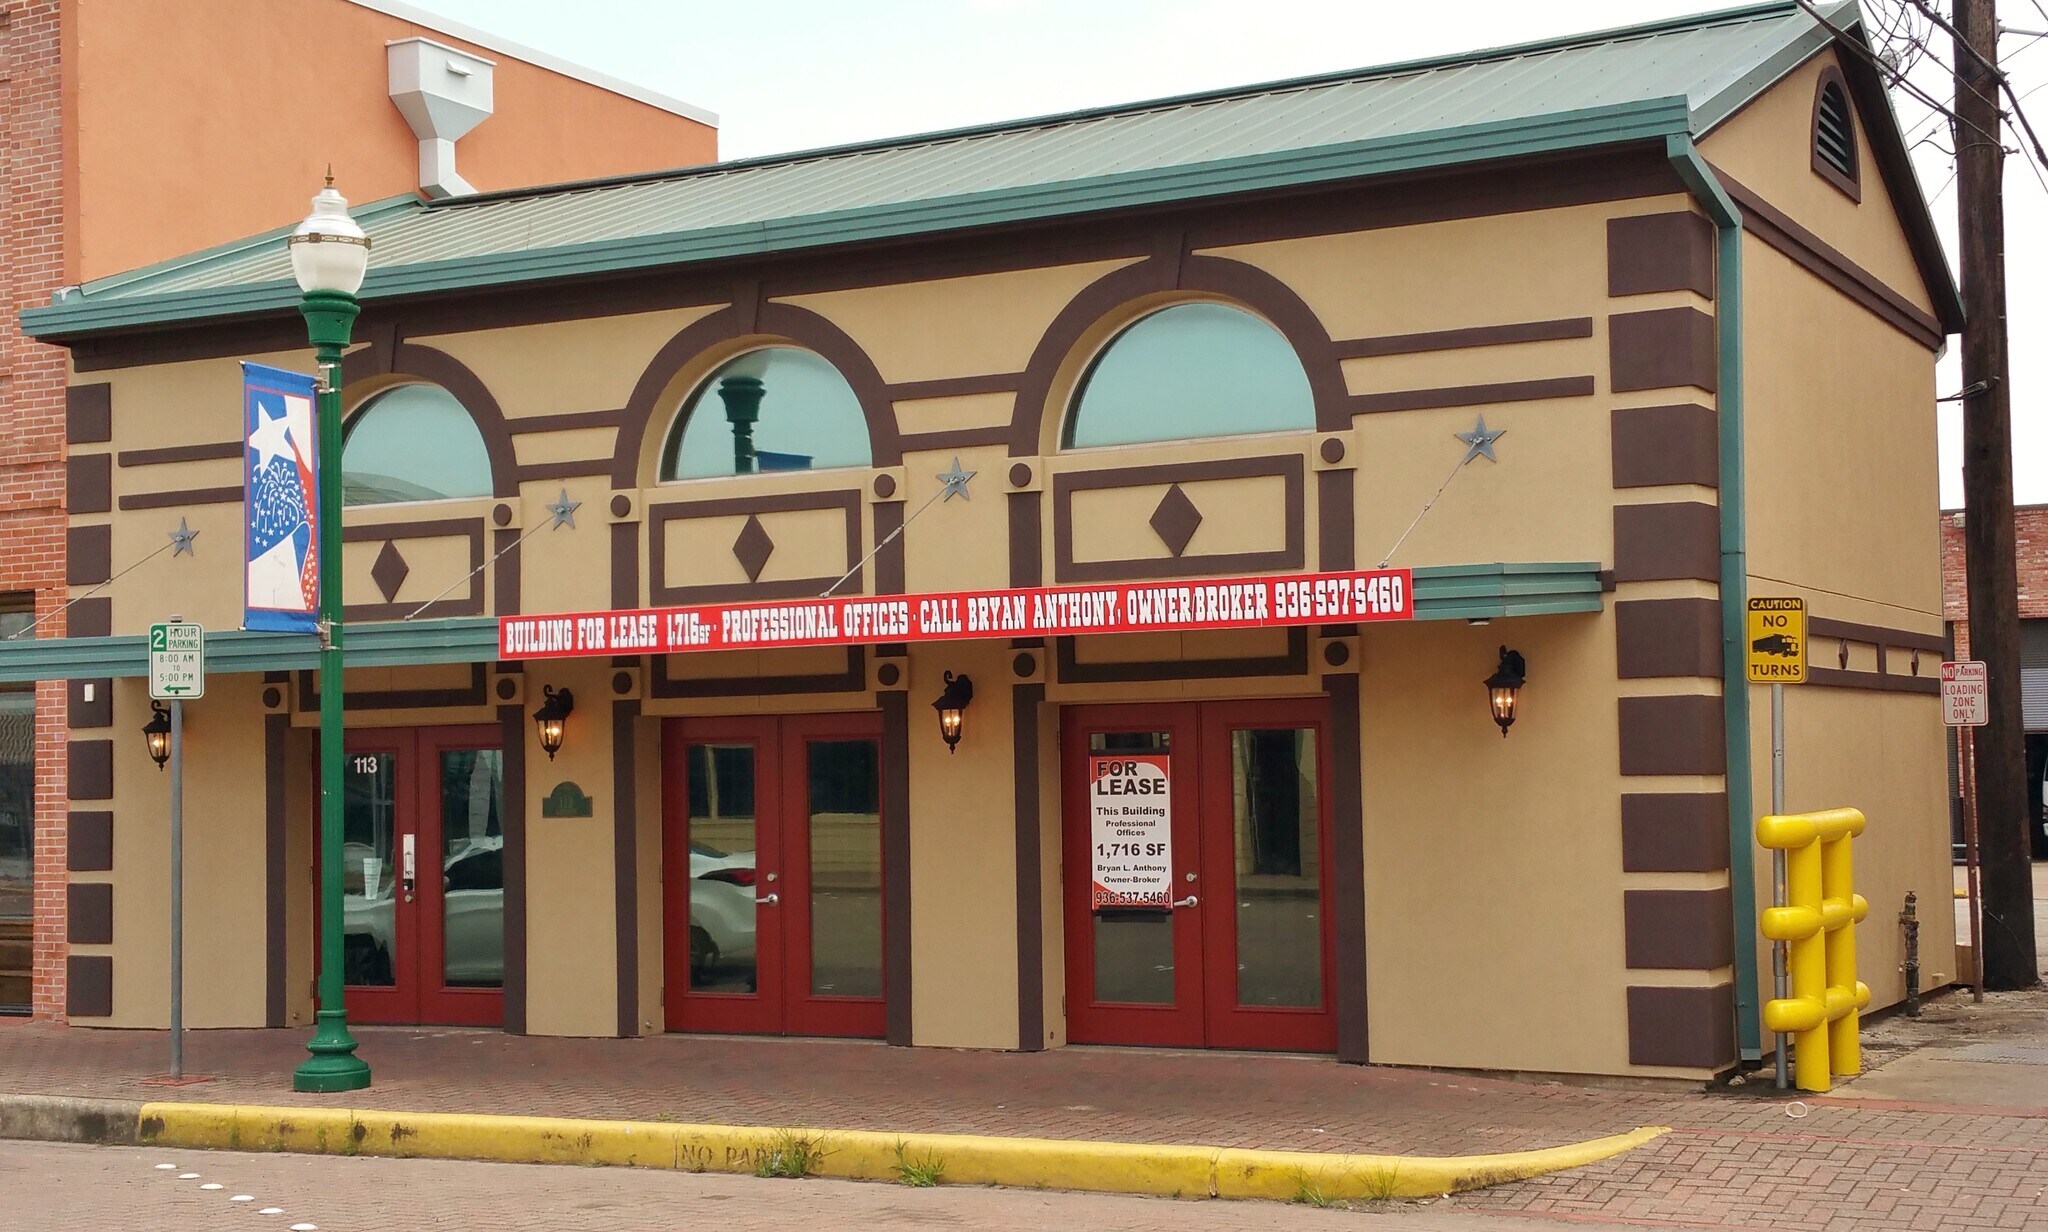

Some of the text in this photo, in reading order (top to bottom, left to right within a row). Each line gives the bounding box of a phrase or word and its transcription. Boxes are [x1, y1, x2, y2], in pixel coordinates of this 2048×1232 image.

[1750, 600, 1801, 609] CAUTION
[505, 618, 573, 654] BUILDING
[577, 616, 606, 650] FOR
[610, 614, 658, 649] LEASE
[721, 604, 839, 643] PROFESSIONAL
[843, 601, 910, 637] OFFICES
[919, 598, 962, 634] CALL
[967, 594, 1027, 632] BRYAN
[1032, 590, 1121, 629] ANTHONY,
[1126, 583, 1269, 625] OWNER/BROKER
[1762, 615, 1788, 628] NO
[152, 628, 197, 648] 2 HOUR
[168, 640, 199, 649] PARKING
[159, 654, 194, 663] 8:00 AM
[172, 664, 181, 672] TO
[1751, 664, 1800, 676] TURNS
[1942, 667, 1983, 679] NO PARKING
[159, 673, 194, 682] 5:00 PM
[1944, 684, 1983, 696] LOADING
[1952, 697, 1976, 707] ZONE
[1952, 709, 1976, 719] ONLY
[354, 757, 378, 774] 113
[1097, 761, 1138, 776] FOR
[1097, 778, 1166, 796] LEASE
[1096, 806, 1166, 817] This Building
[1105, 820, 1156, 828] Professional
[1116, 829, 1146, 837] Offices
[1096, 843, 1166, 859] 1,716 SF
[1097, 864, 1167, 873] Bryan L. Anthony
[1104, 876, 1160, 884] Owner-Broker
[1096, 891, 1170, 904] 936-537-5460
[682, 1144, 713, 1165] NO
